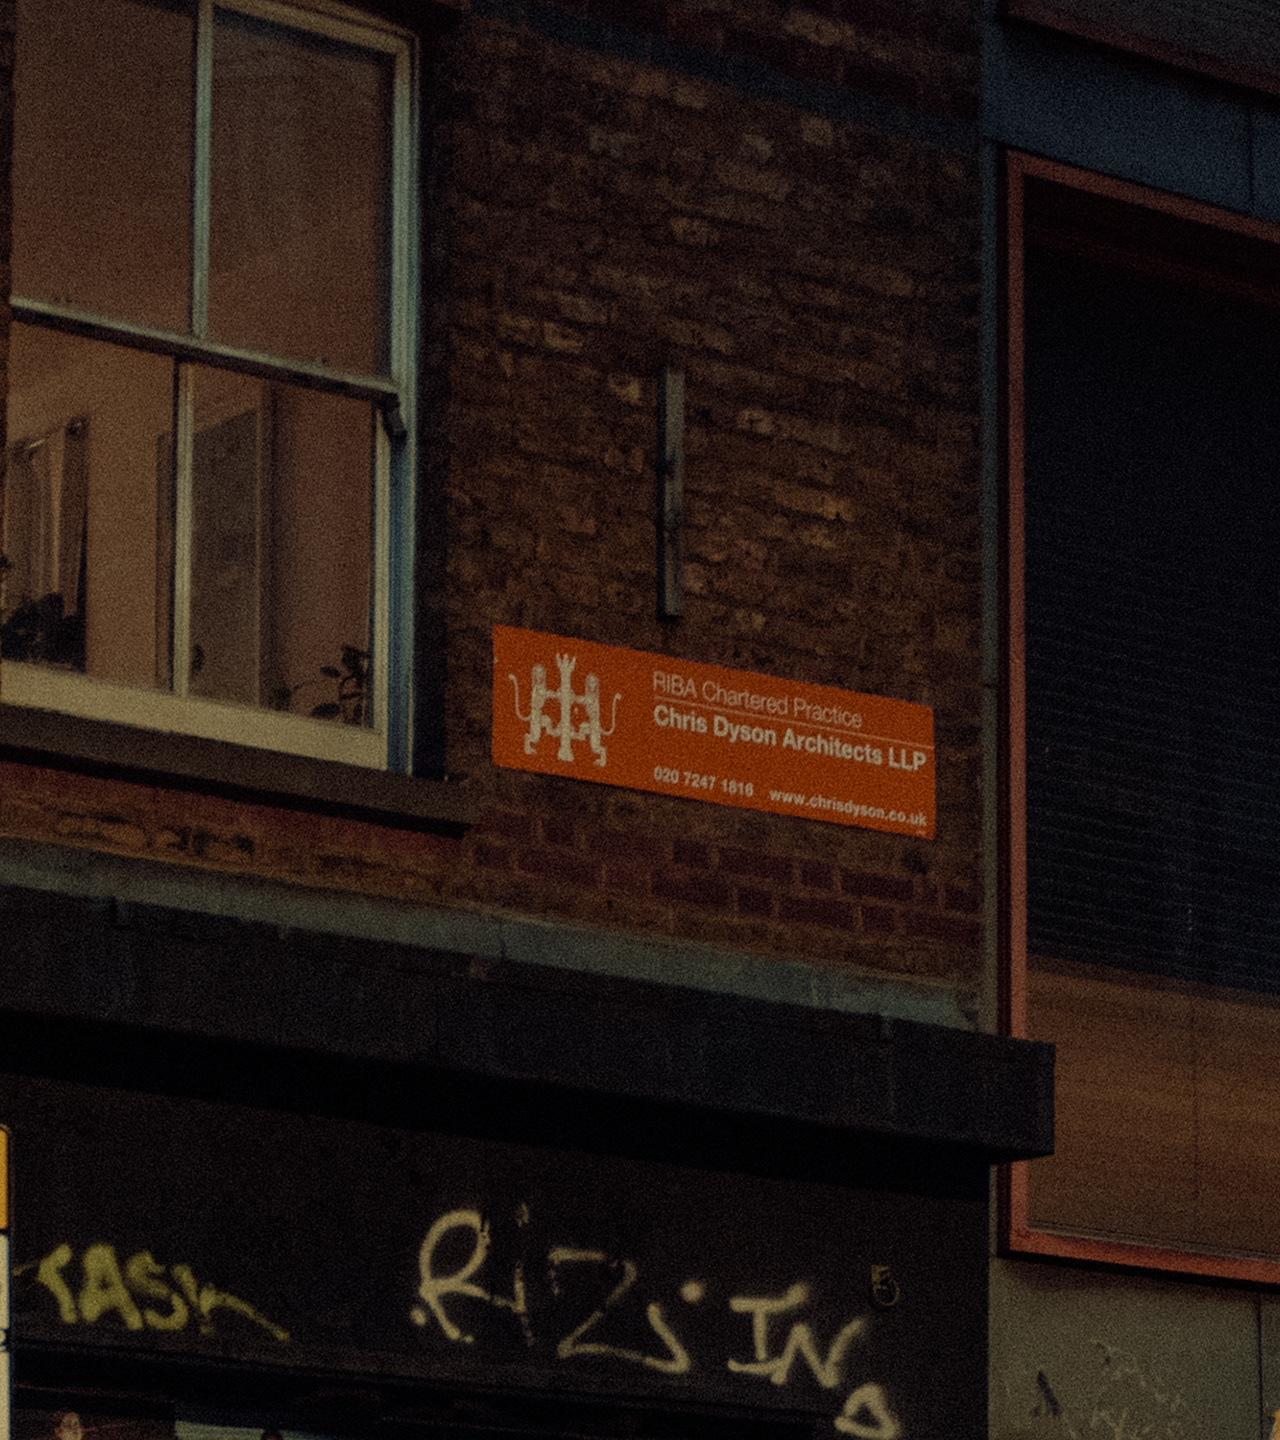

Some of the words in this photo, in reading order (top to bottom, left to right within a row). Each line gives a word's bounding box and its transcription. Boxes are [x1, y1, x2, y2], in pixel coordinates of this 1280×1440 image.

[652, 670, 698, 699] RIBA
[701, 679, 789, 718] Chartered
[793, 698, 864, 730] Practice
[652, 703, 708, 736] Chris
[712, 713, 777, 748] Dyson
[781, 726, 884, 767] Architects
[887, 746, 927, 773] LLP
[652, 765, 679, 784] 020
[682, 769, 717, 792] 7247
[768, 787, 928, 828] www.chrisdyson.co.uk
